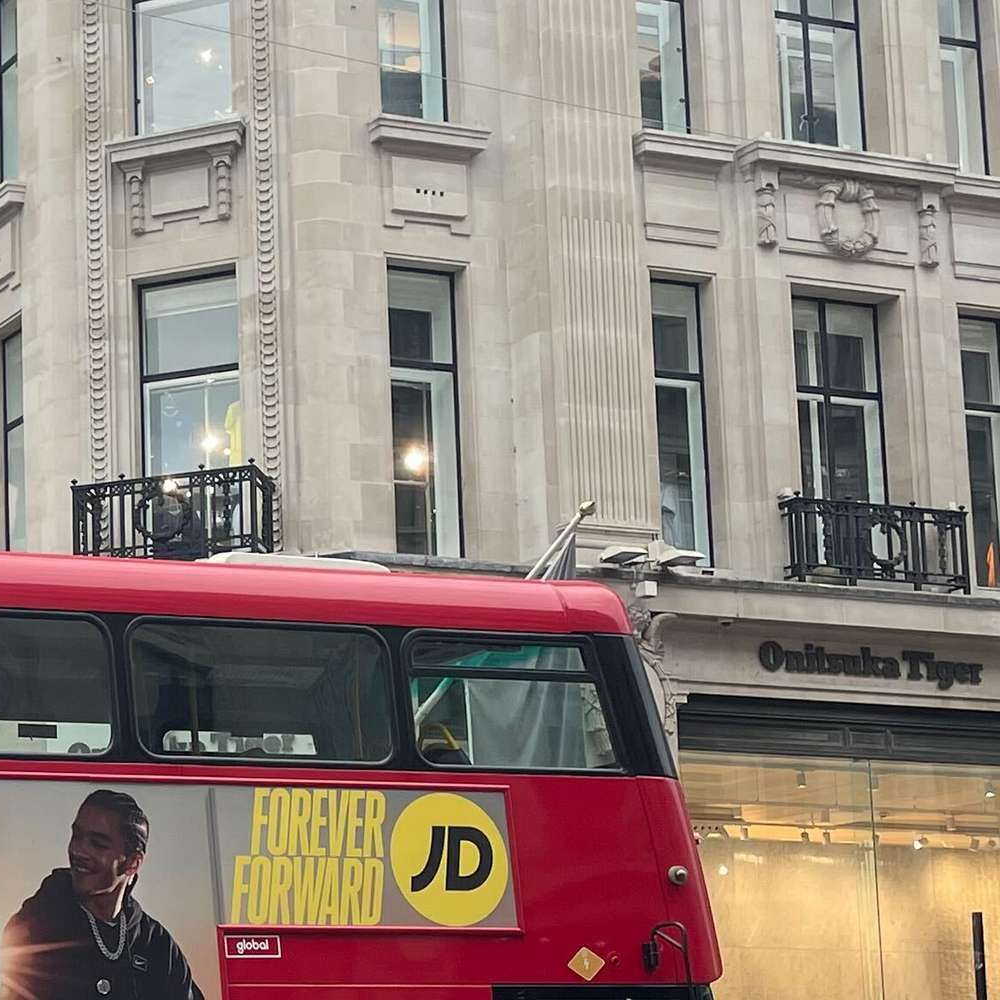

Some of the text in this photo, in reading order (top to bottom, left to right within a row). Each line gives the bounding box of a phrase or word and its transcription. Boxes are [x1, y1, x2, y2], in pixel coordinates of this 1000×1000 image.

[759, 641, 984, 690] Onitsuka Tiger
[251, 787, 386, 858] FOREVER
[231, 855, 385, 925] FORWARD
[411, 825, 493, 892] JD
[236, 938, 269, 955] global
